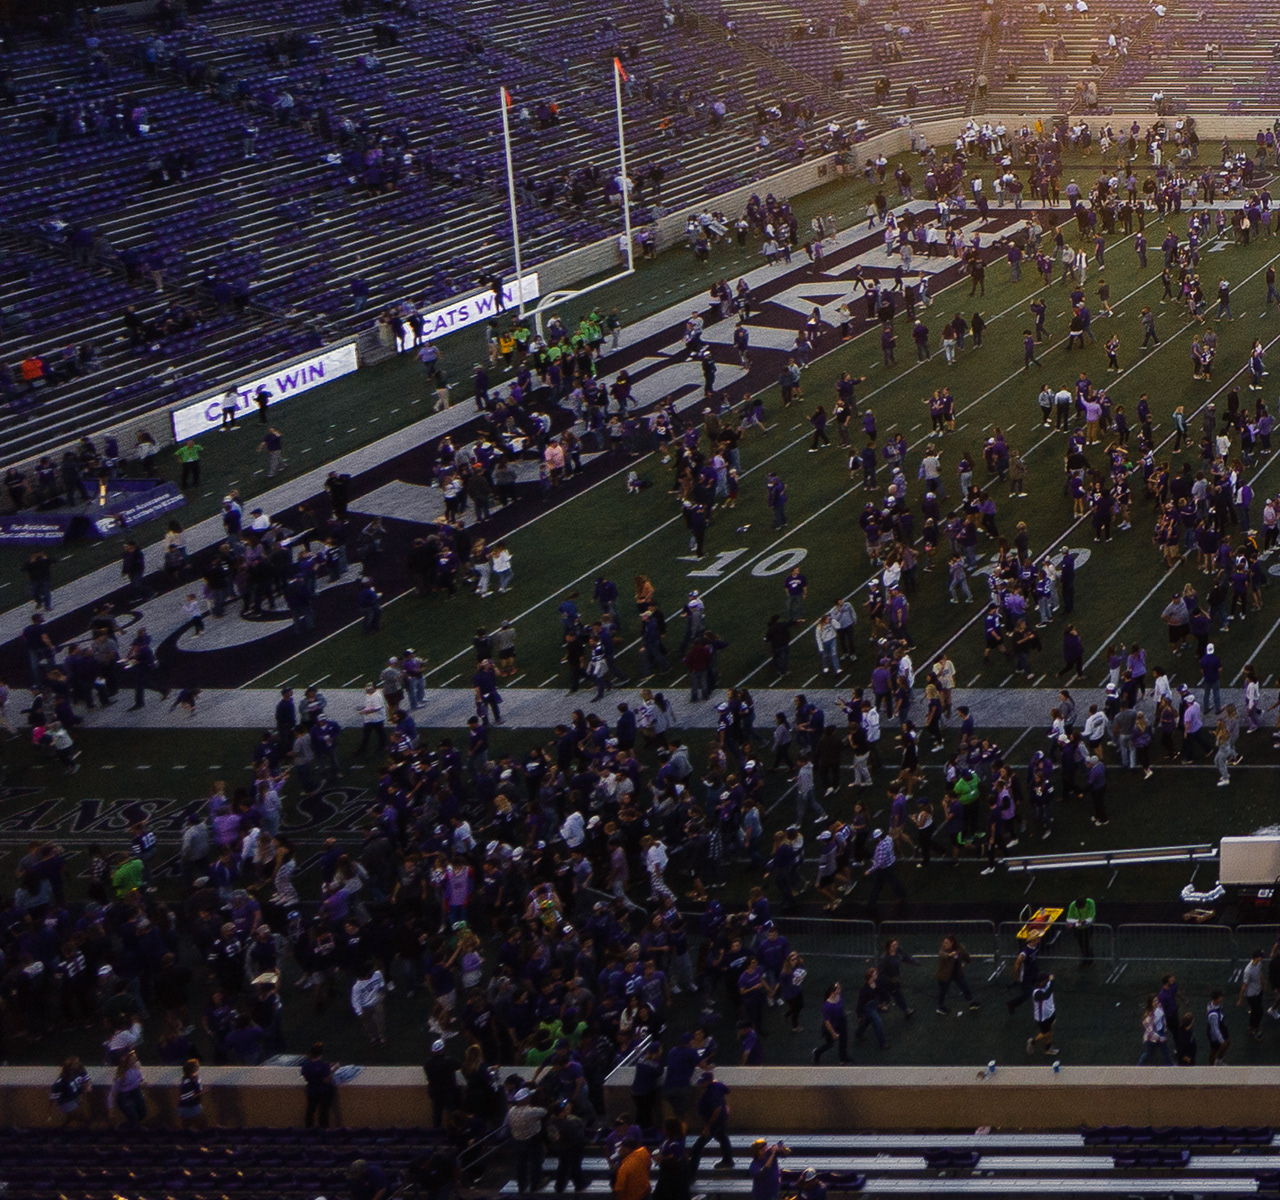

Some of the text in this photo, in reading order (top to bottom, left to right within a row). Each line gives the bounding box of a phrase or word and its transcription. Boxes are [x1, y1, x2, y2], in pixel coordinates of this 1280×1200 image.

[421, 287, 513, 335] CATS WN
[276, 361, 325, 393] WIN
[685, 547, 809, 578] 10
